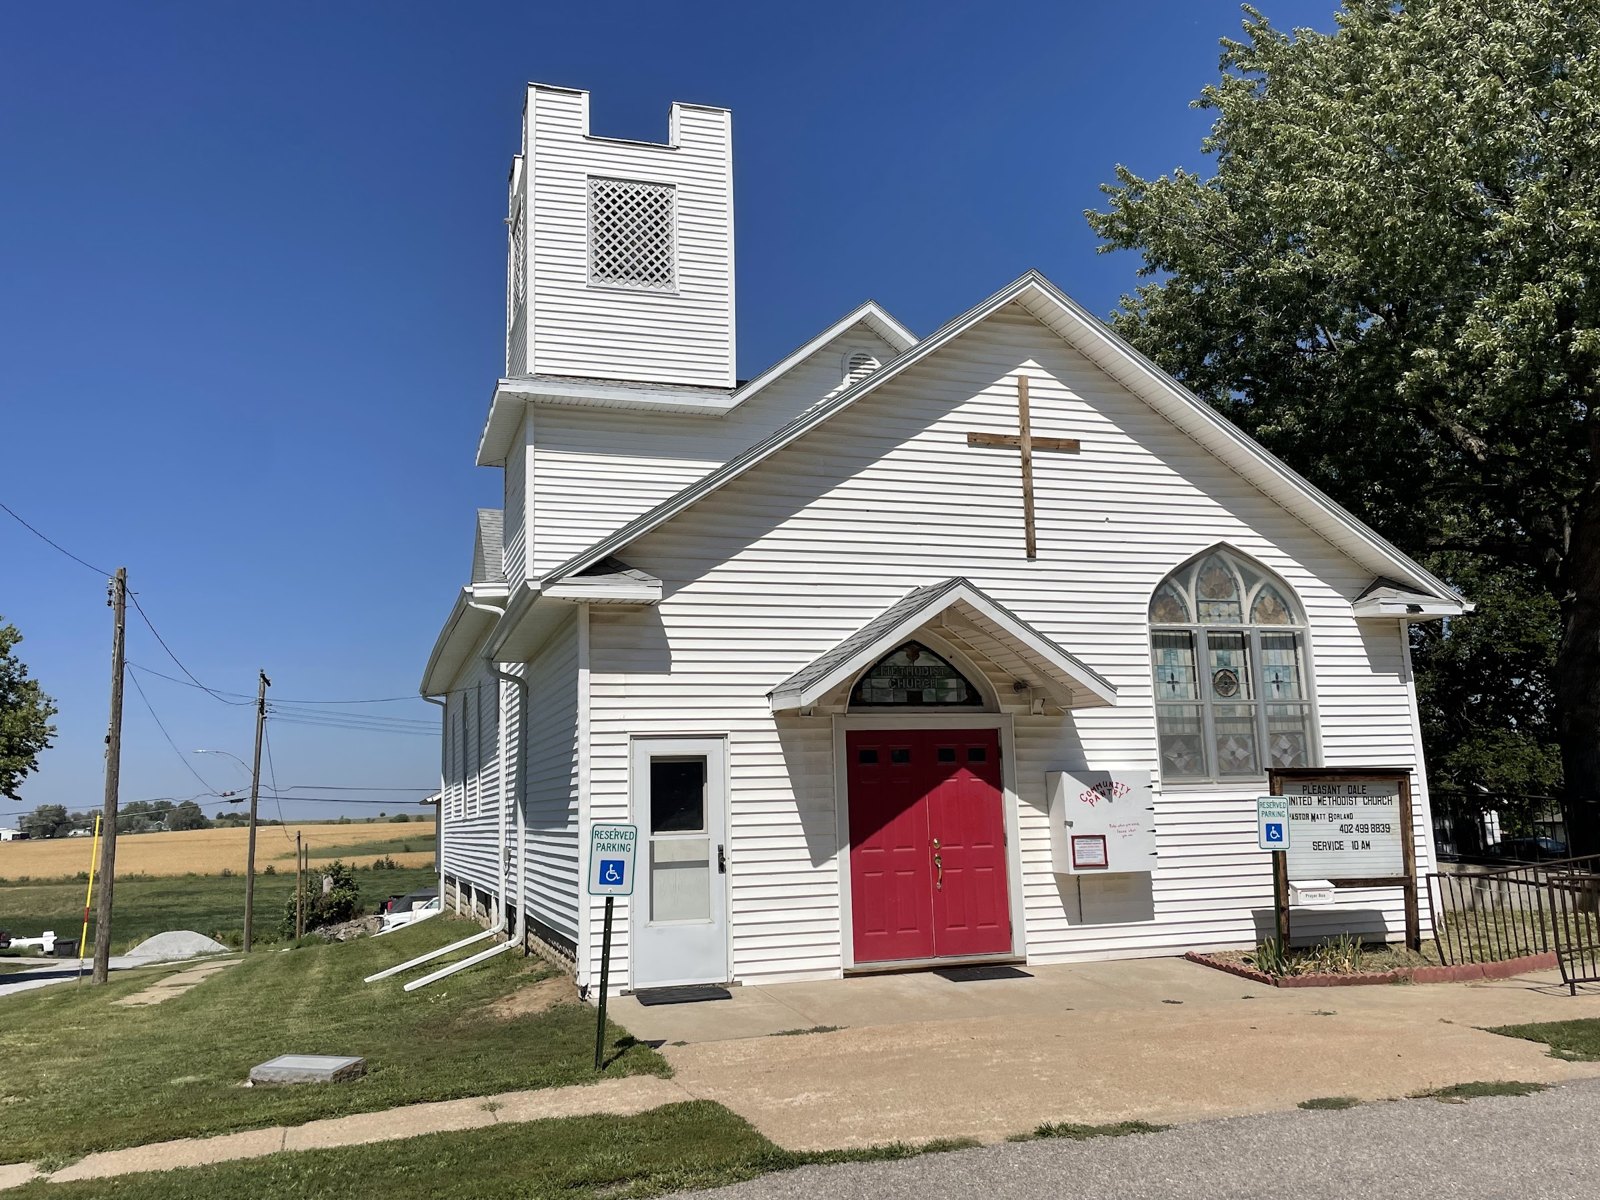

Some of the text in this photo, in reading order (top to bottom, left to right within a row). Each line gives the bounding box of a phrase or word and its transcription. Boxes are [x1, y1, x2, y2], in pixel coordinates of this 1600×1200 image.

[880, 666, 945, 677] METHODIST
[888, 678, 938, 689] CHURCH
[1079, 781, 1131, 802] COMMUNITY
[1302, 785, 1367, 795] PLEASANT DALE
[1088, 788, 1124, 807] PANTRY
[1317, 796, 1357, 806] METHODIST
[1363, 796, 1393, 806] CHURCH
[1259, 801, 1287, 809] RESERVED
[1261, 810, 1285, 818] PARKING
[1289, 813, 1310, 821] ASTOR
[1339, 823, 1391, 834] 402 499 8839
[594, 830, 635, 840] RESERVED
[596, 842, 631, 852] PARKING
[1312, 840, 1371, 851] SERVICE 10 AM
